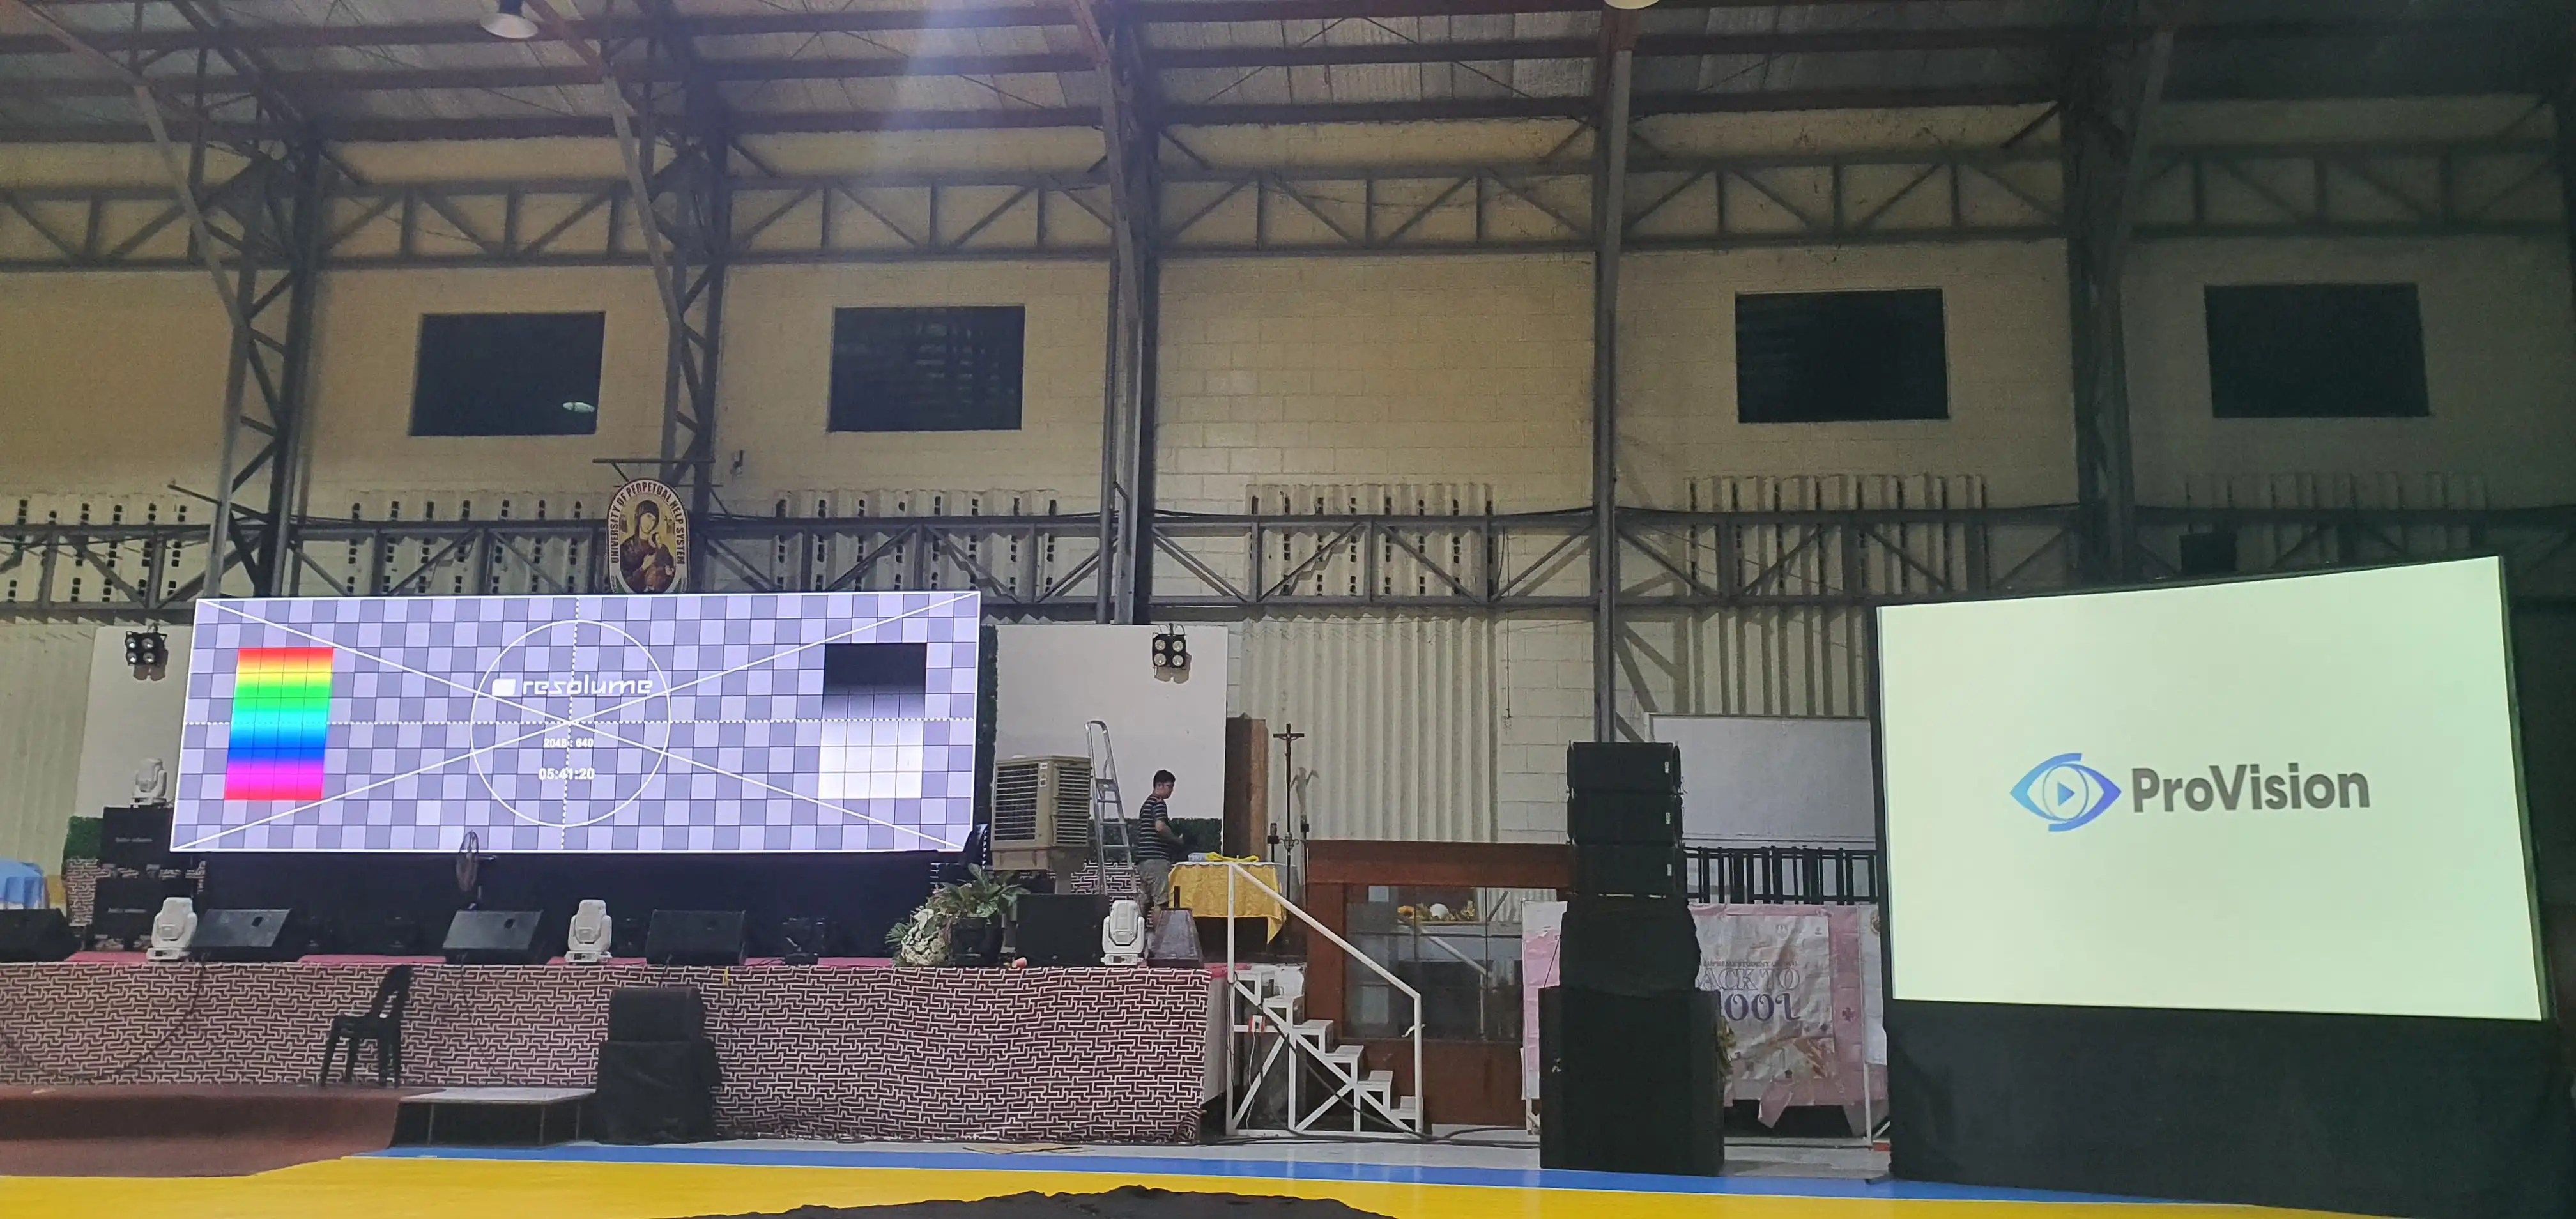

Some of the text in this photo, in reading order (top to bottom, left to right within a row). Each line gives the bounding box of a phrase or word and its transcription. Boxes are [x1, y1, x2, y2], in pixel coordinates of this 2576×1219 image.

[610, 482, 685, 565] UNIVERSITY OF PERPETUAL HELP SYSTEM
[523, 674, 653, 695] resolume
[543, 738, 567, 748] 2048
[576, 737, 594, 748] 640
[538, 767, 595, 780] 05:41:20
[2132, 762, 2371, 813] ProVision
[1695, 967, 1800, 990] ACK TO
[1724, 993, 1801, 1021] OOL
